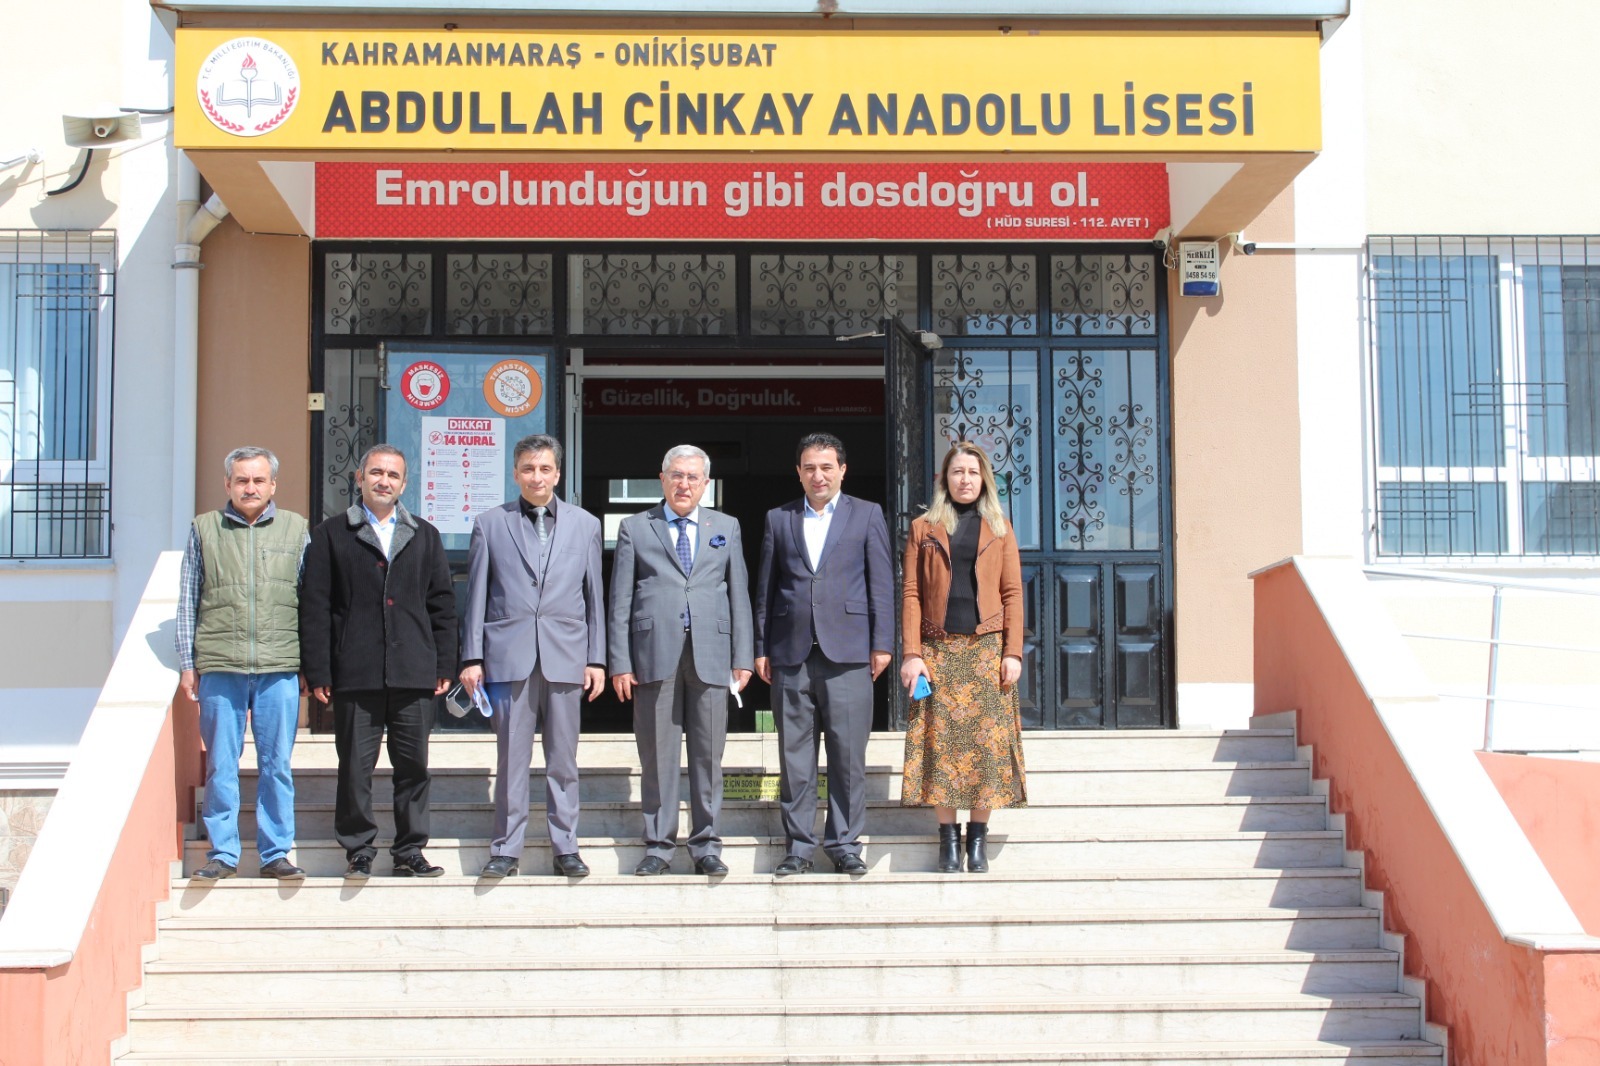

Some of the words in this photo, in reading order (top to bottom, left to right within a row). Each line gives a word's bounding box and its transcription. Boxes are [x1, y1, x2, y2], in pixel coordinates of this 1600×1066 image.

[321, 41, 582, 69] KAHRAMANMARAŞ
[614, 36, 777, 71] ONİKİŞUBAT
[321, 90, 603, 136] ABDULLAH
[623, 80, 814, 143] ÇİNKAY
[828, 92, 1072, 137] ANADOLU
[1093, 80, 1254, 137] LİSESİ
[376, 168, 708, 216] Emrolunduğun
[724, 171, 804, 217] gibi
[820, 169, 1033, 217] dosdoğru
[1050, 171, 1099, 207] ol.
[1025, 215, 1070, 228] SURESİ
[1080, 217, 1107, 228] 112.
[1110, 217, 1141, 228] AYET
[489, 363, 530, 381] TEMASTAN
[601, 388, 691, 409] Güzellik,
[697, 387, 801, 410] Doğruluk.
[444, 435, 456, 446] 14
[458, 435, 496, 447] KURAL
